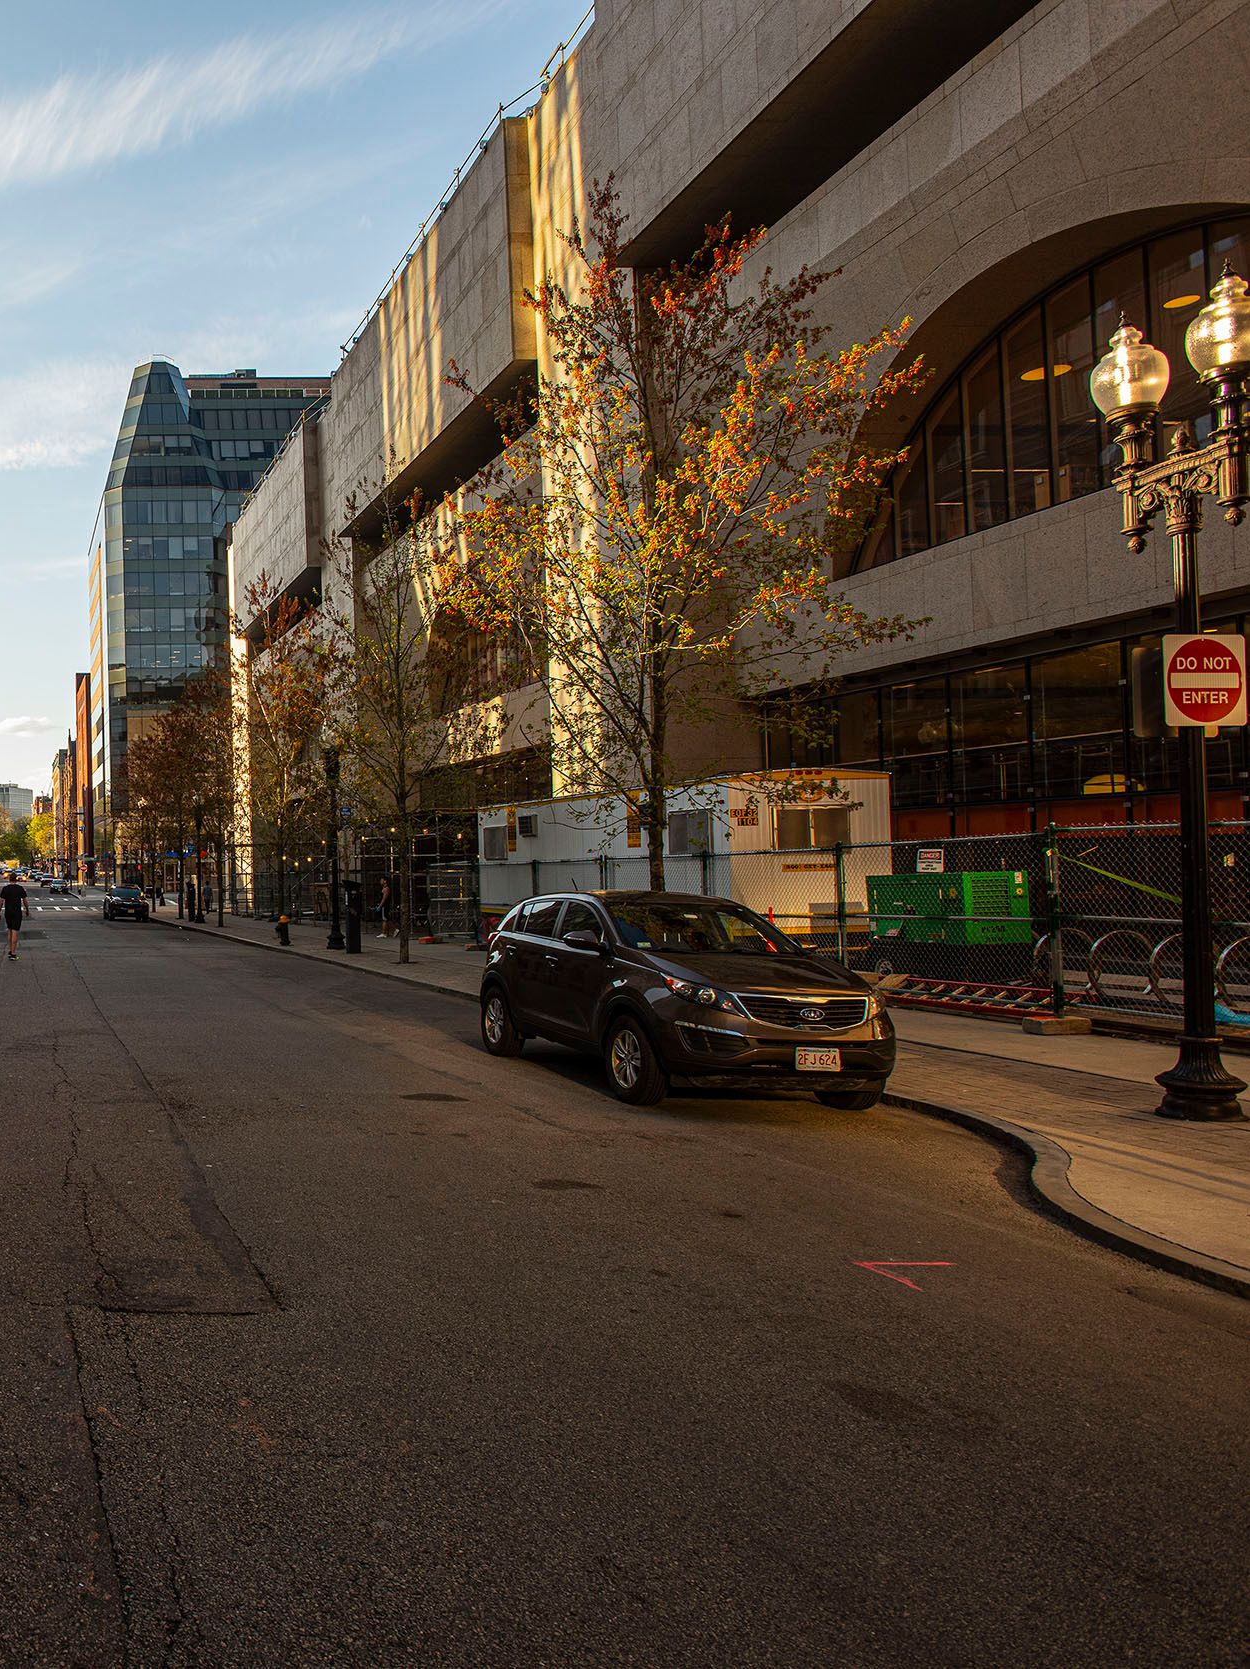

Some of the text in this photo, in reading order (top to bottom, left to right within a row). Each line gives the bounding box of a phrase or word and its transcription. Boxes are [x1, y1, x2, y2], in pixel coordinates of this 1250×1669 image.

[1176, 657, 1232, 670] DO NOT
[1182, 691, 1229, 704] ENTER
